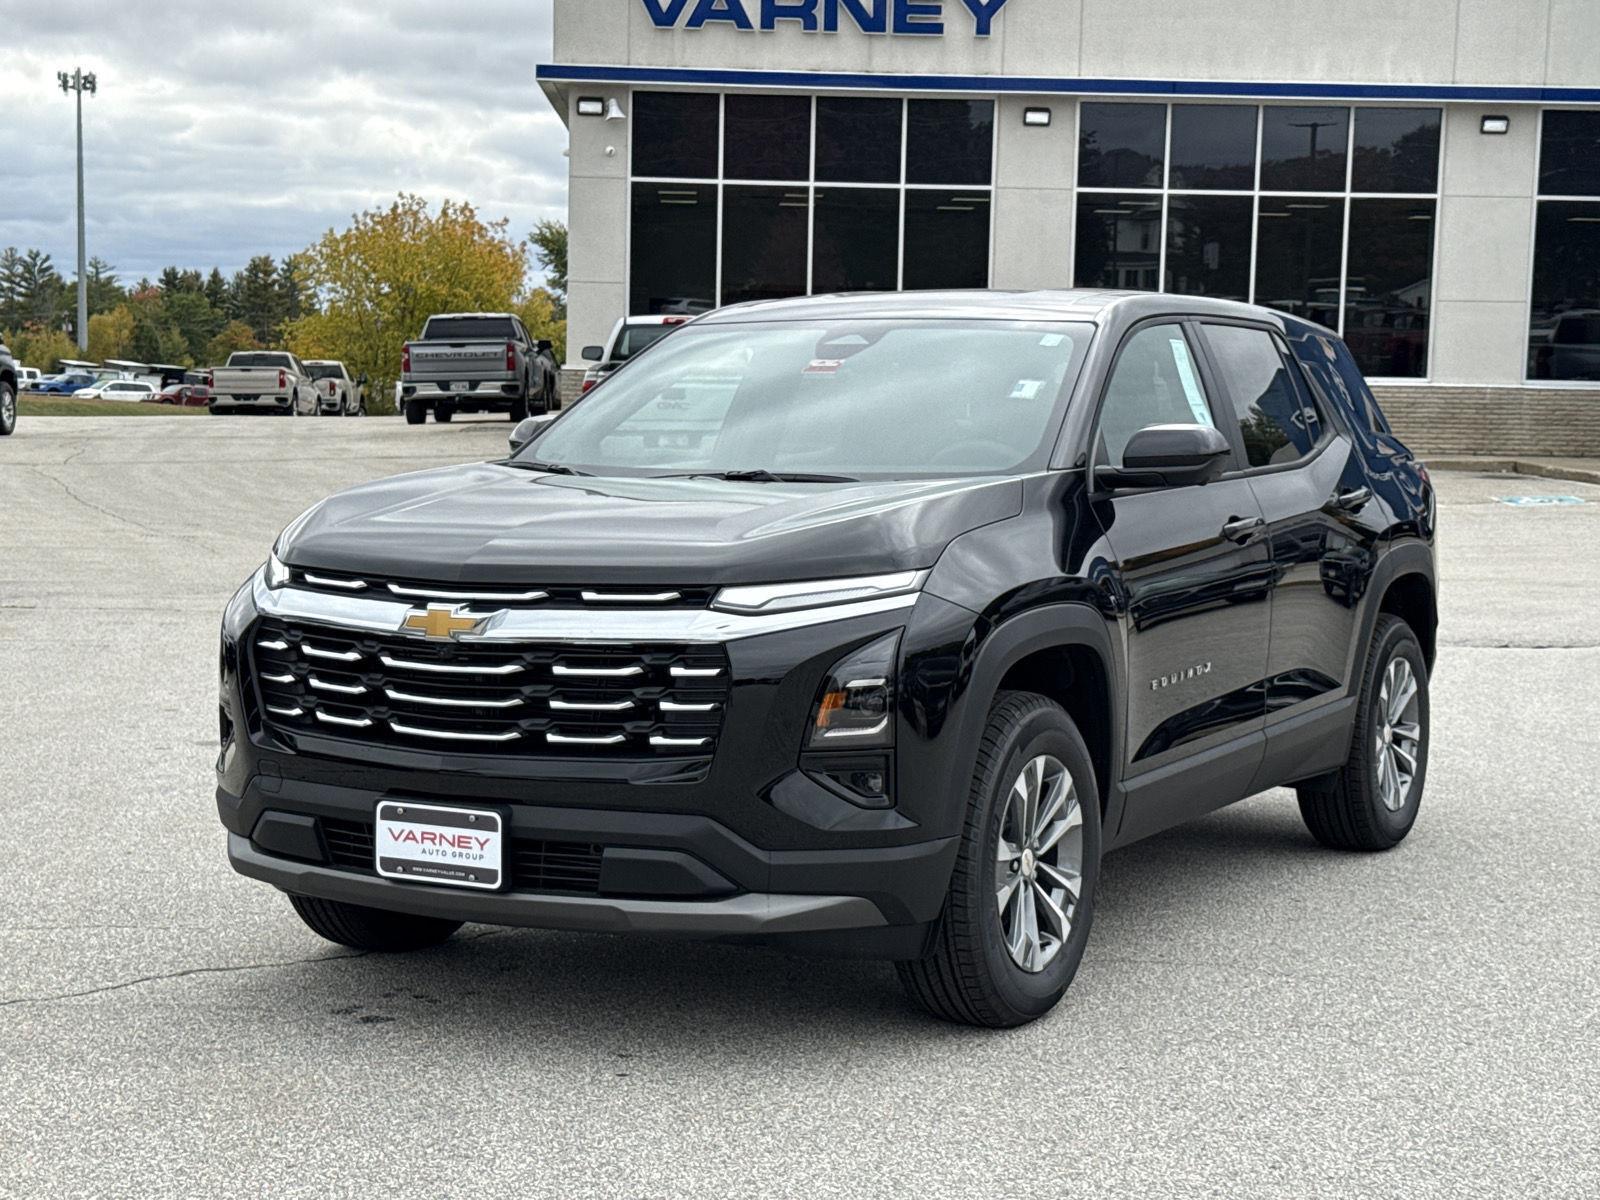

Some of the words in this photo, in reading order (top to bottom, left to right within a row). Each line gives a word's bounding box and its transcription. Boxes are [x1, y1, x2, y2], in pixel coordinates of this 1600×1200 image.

[641, 0, 1006, 36] VARNEY
[415, 351, 498, 359] CHEVROLET
[387, 826, 491, 851] VARNEY
[421, 848, 447, 857] AUTO
[451, 851, 485, 861] GROUP
